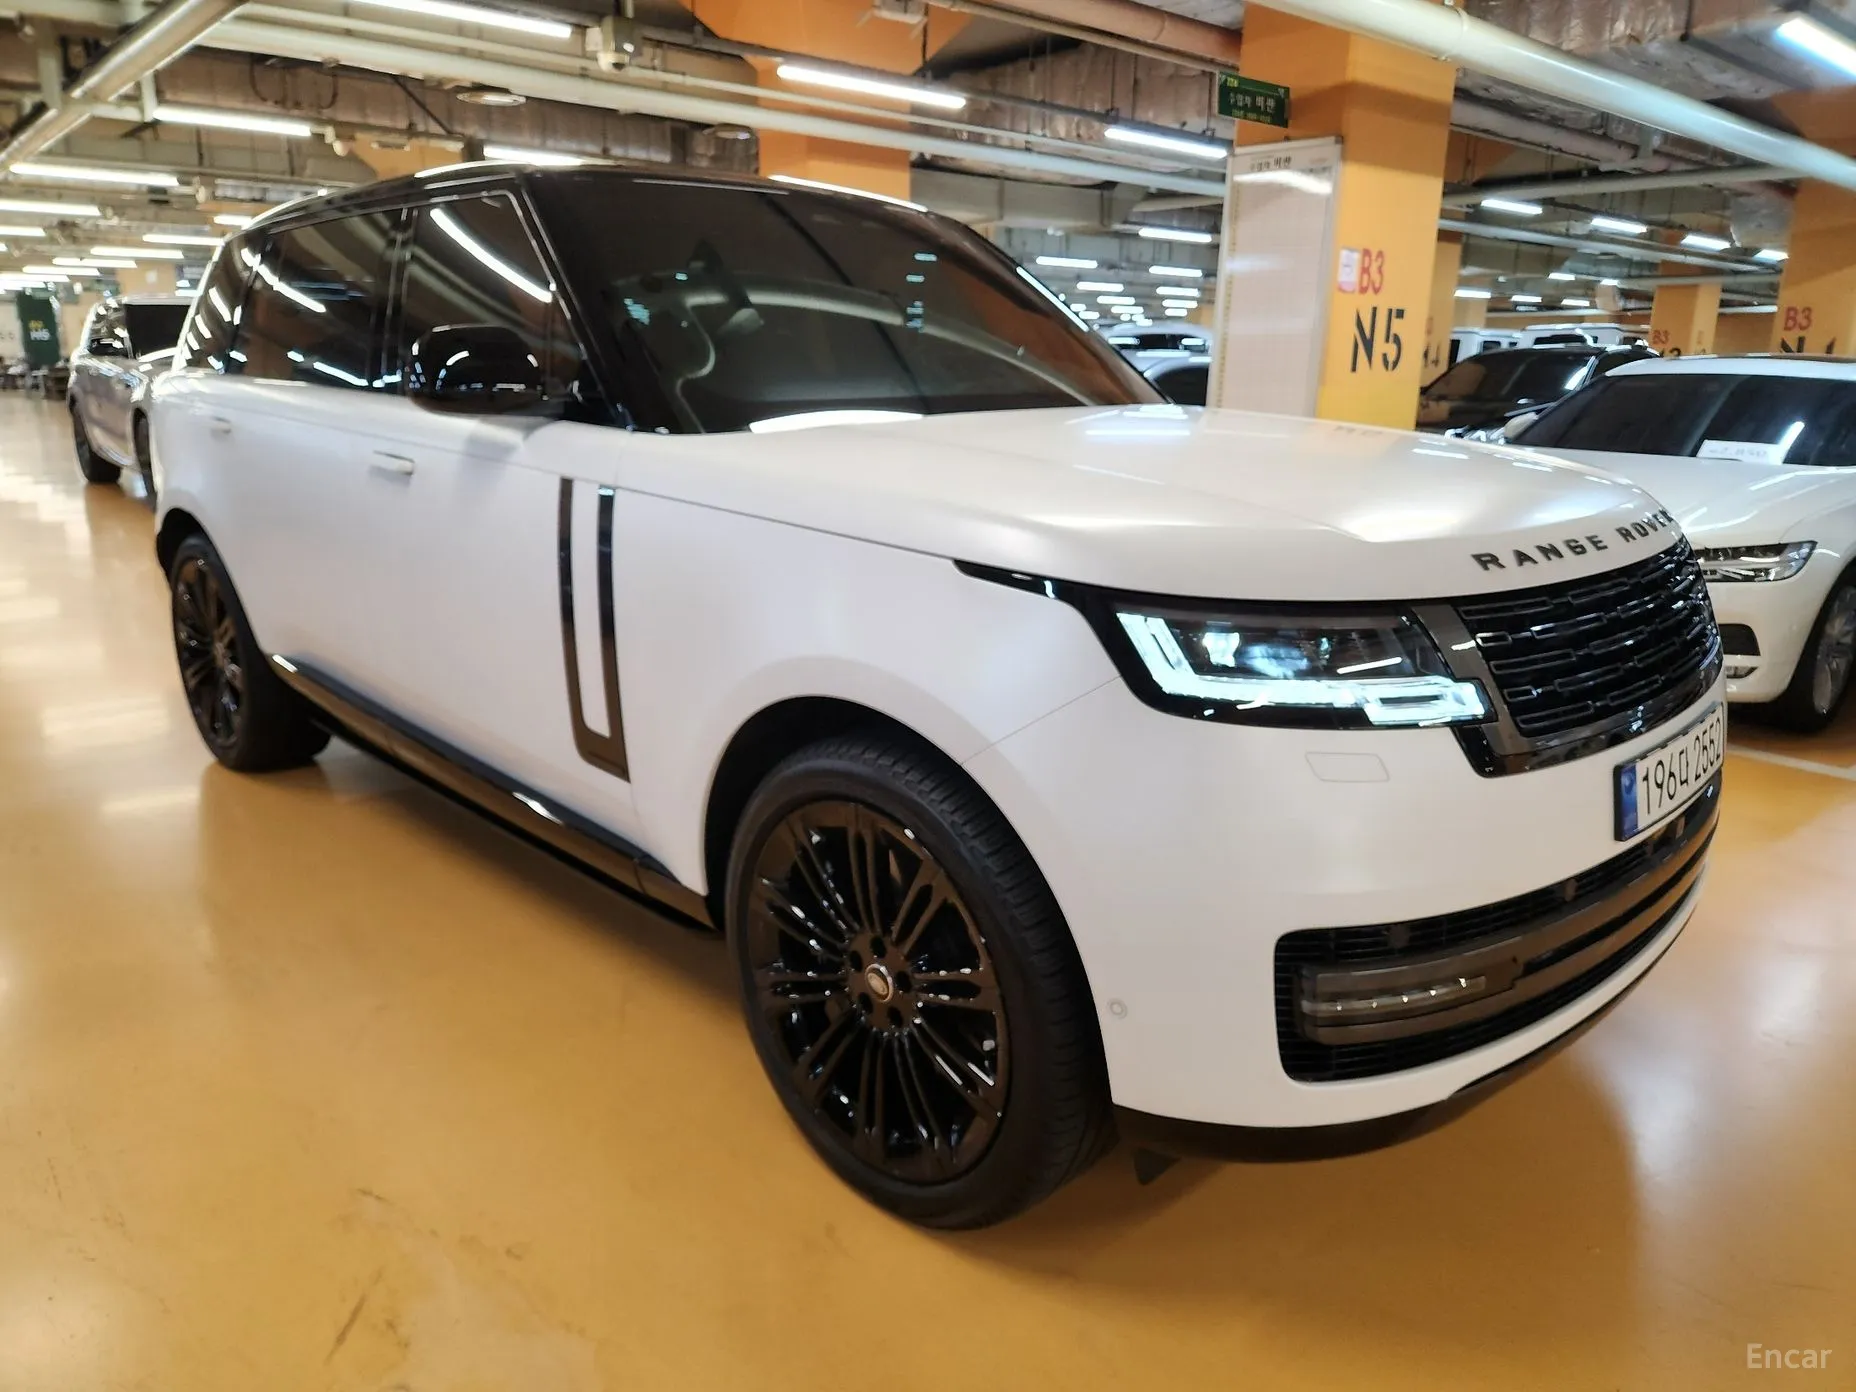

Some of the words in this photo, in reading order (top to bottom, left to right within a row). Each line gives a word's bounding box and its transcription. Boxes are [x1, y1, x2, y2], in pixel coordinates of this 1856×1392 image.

[1358, 247, 1384, 295] B3
[1350, 306, 1405, 373] N5
[1783, 306, 1812, 332] B3
[1470, 534, 1609, 572] RANGE
[1693, 716, 1721, 782] 2552
